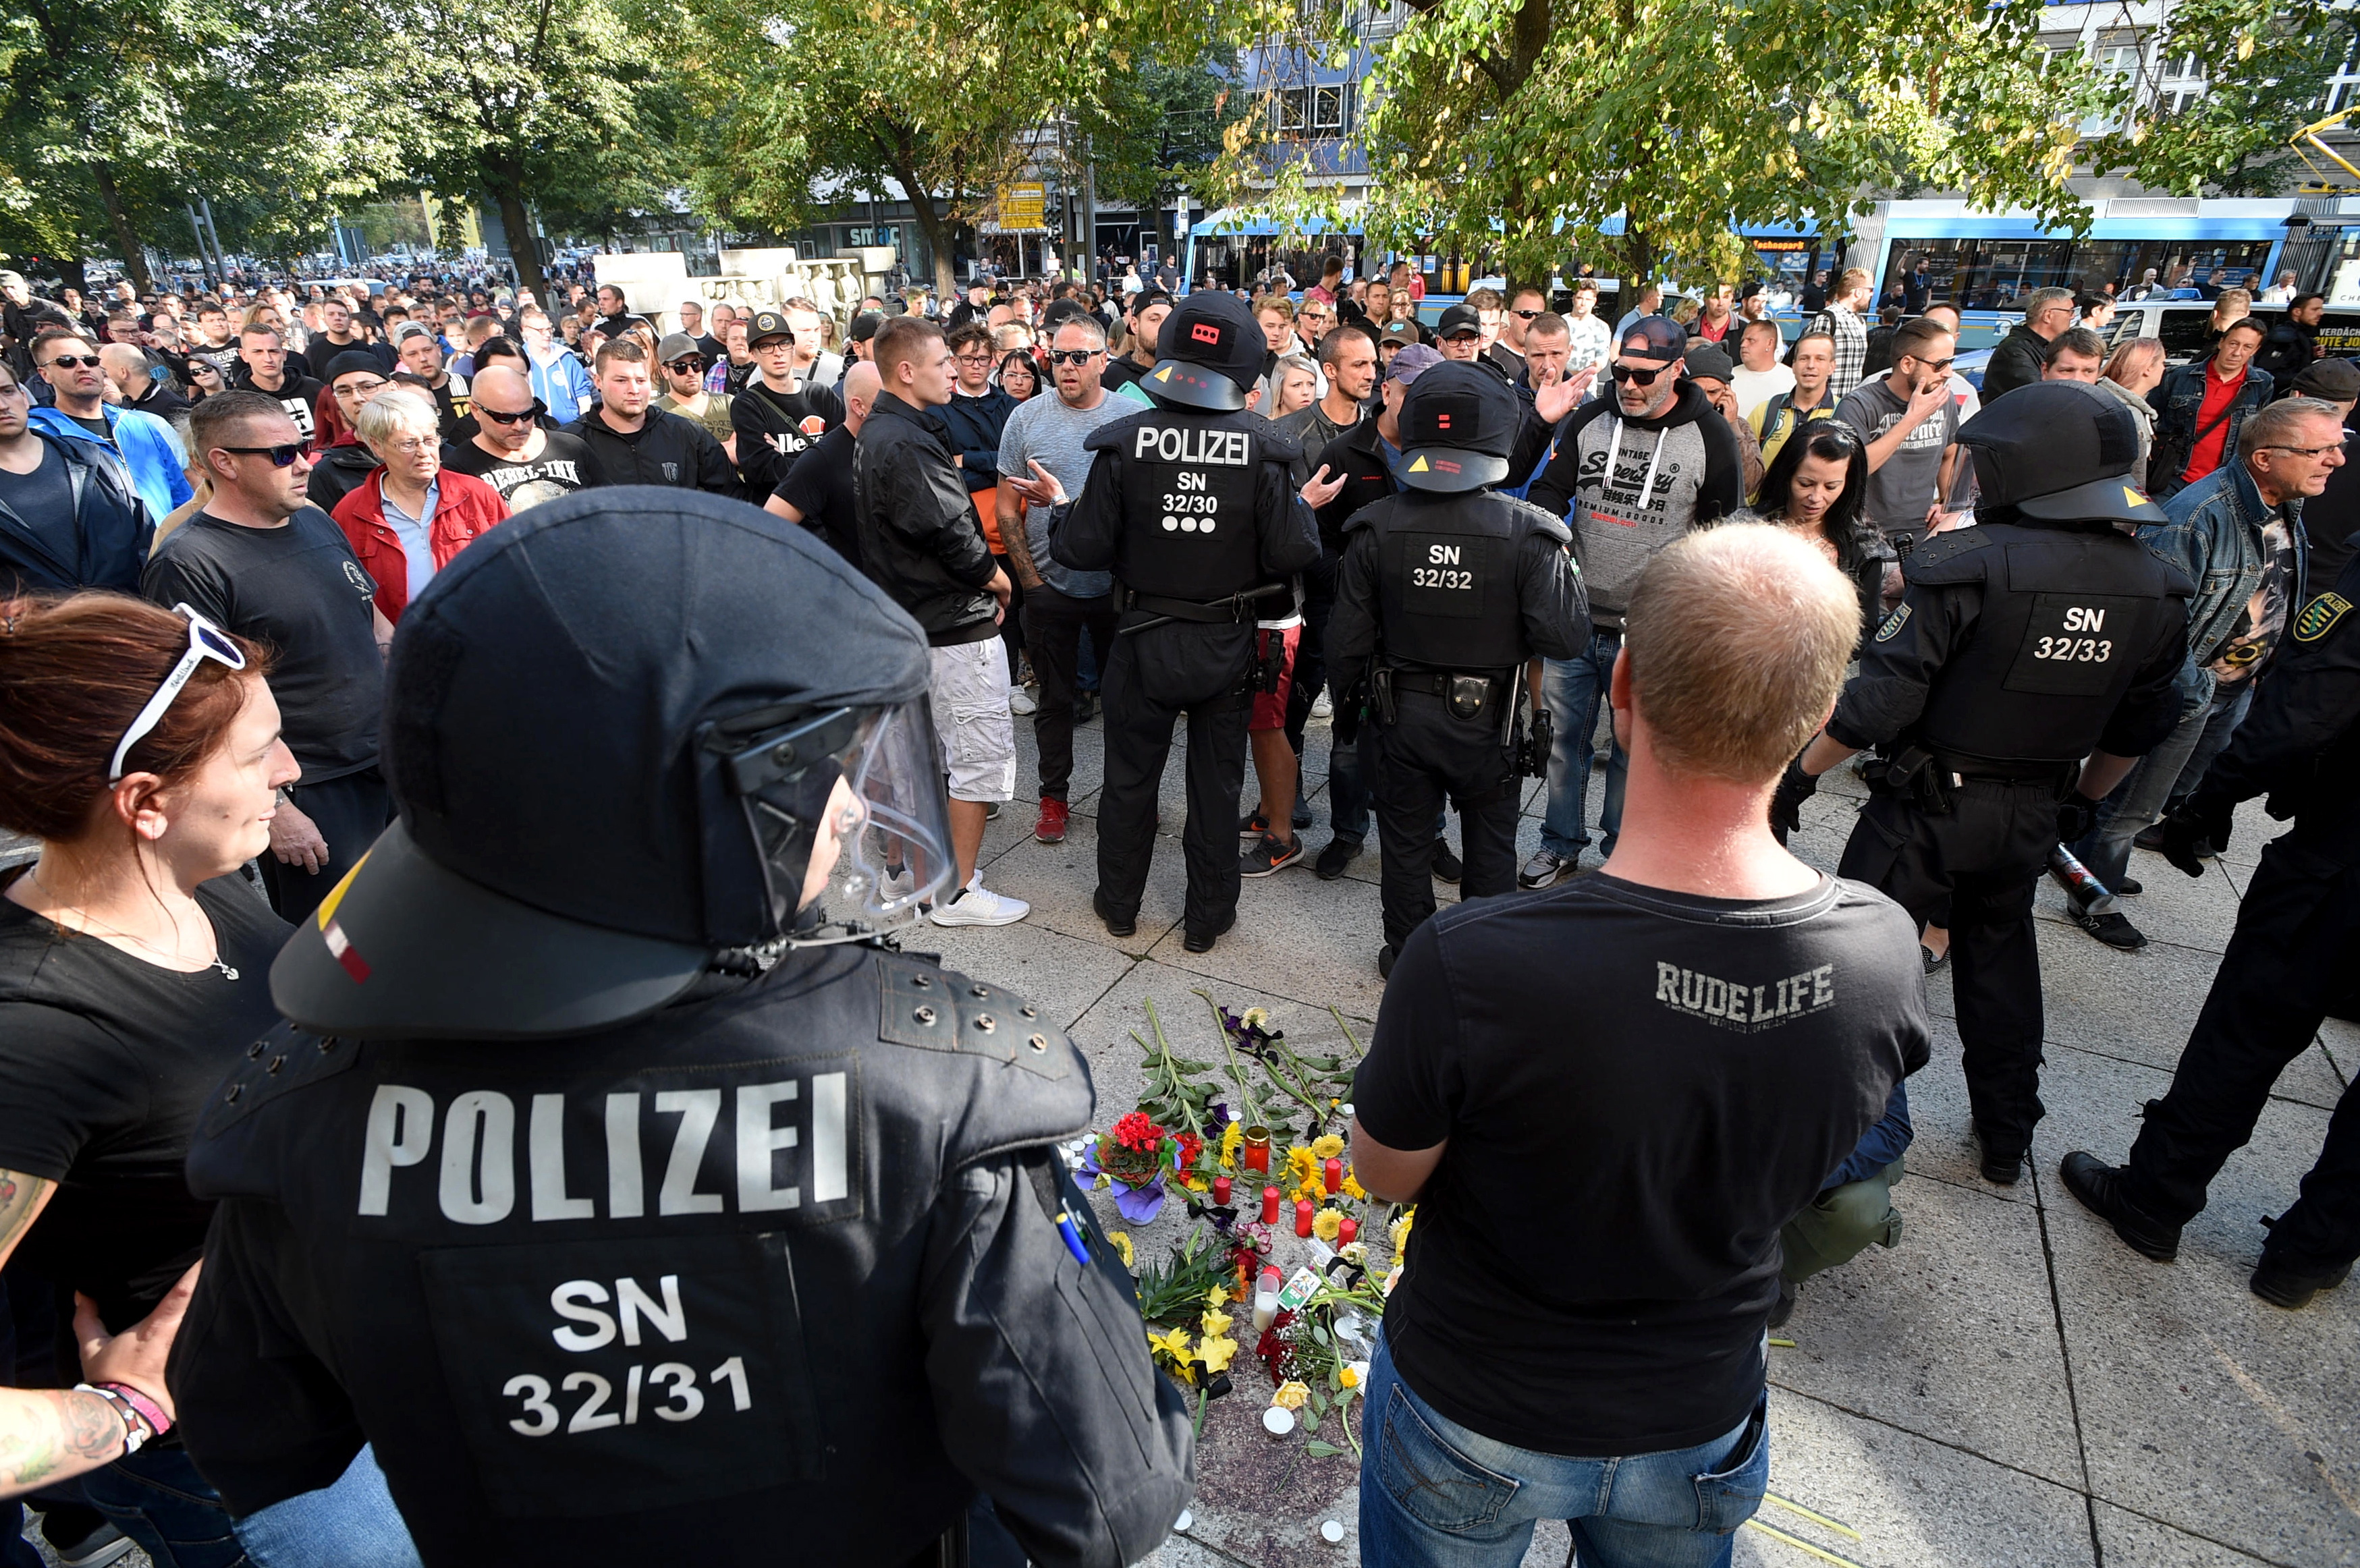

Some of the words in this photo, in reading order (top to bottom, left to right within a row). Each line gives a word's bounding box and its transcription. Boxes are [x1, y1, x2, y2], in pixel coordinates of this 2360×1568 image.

[1135, 426, 1249, 466] POLIZEI
[480, 459, 582, 493] REBEL-INK
[1177, 472, 1207, 492] SN
[1162, 493, 1218, 514] 32/30
[1428, 544, 1460, 565] SN
[1412, 568, 1473, 590] 32/32
[2062, 607, 2106, 633] SN
[2034, 636, 2112, 663] 32/33
[358, 1071, 848, 1225] POLIZEI
[550, 1274, 687, 1352] SN
[502, 1355, 752, 1437] 32/31
